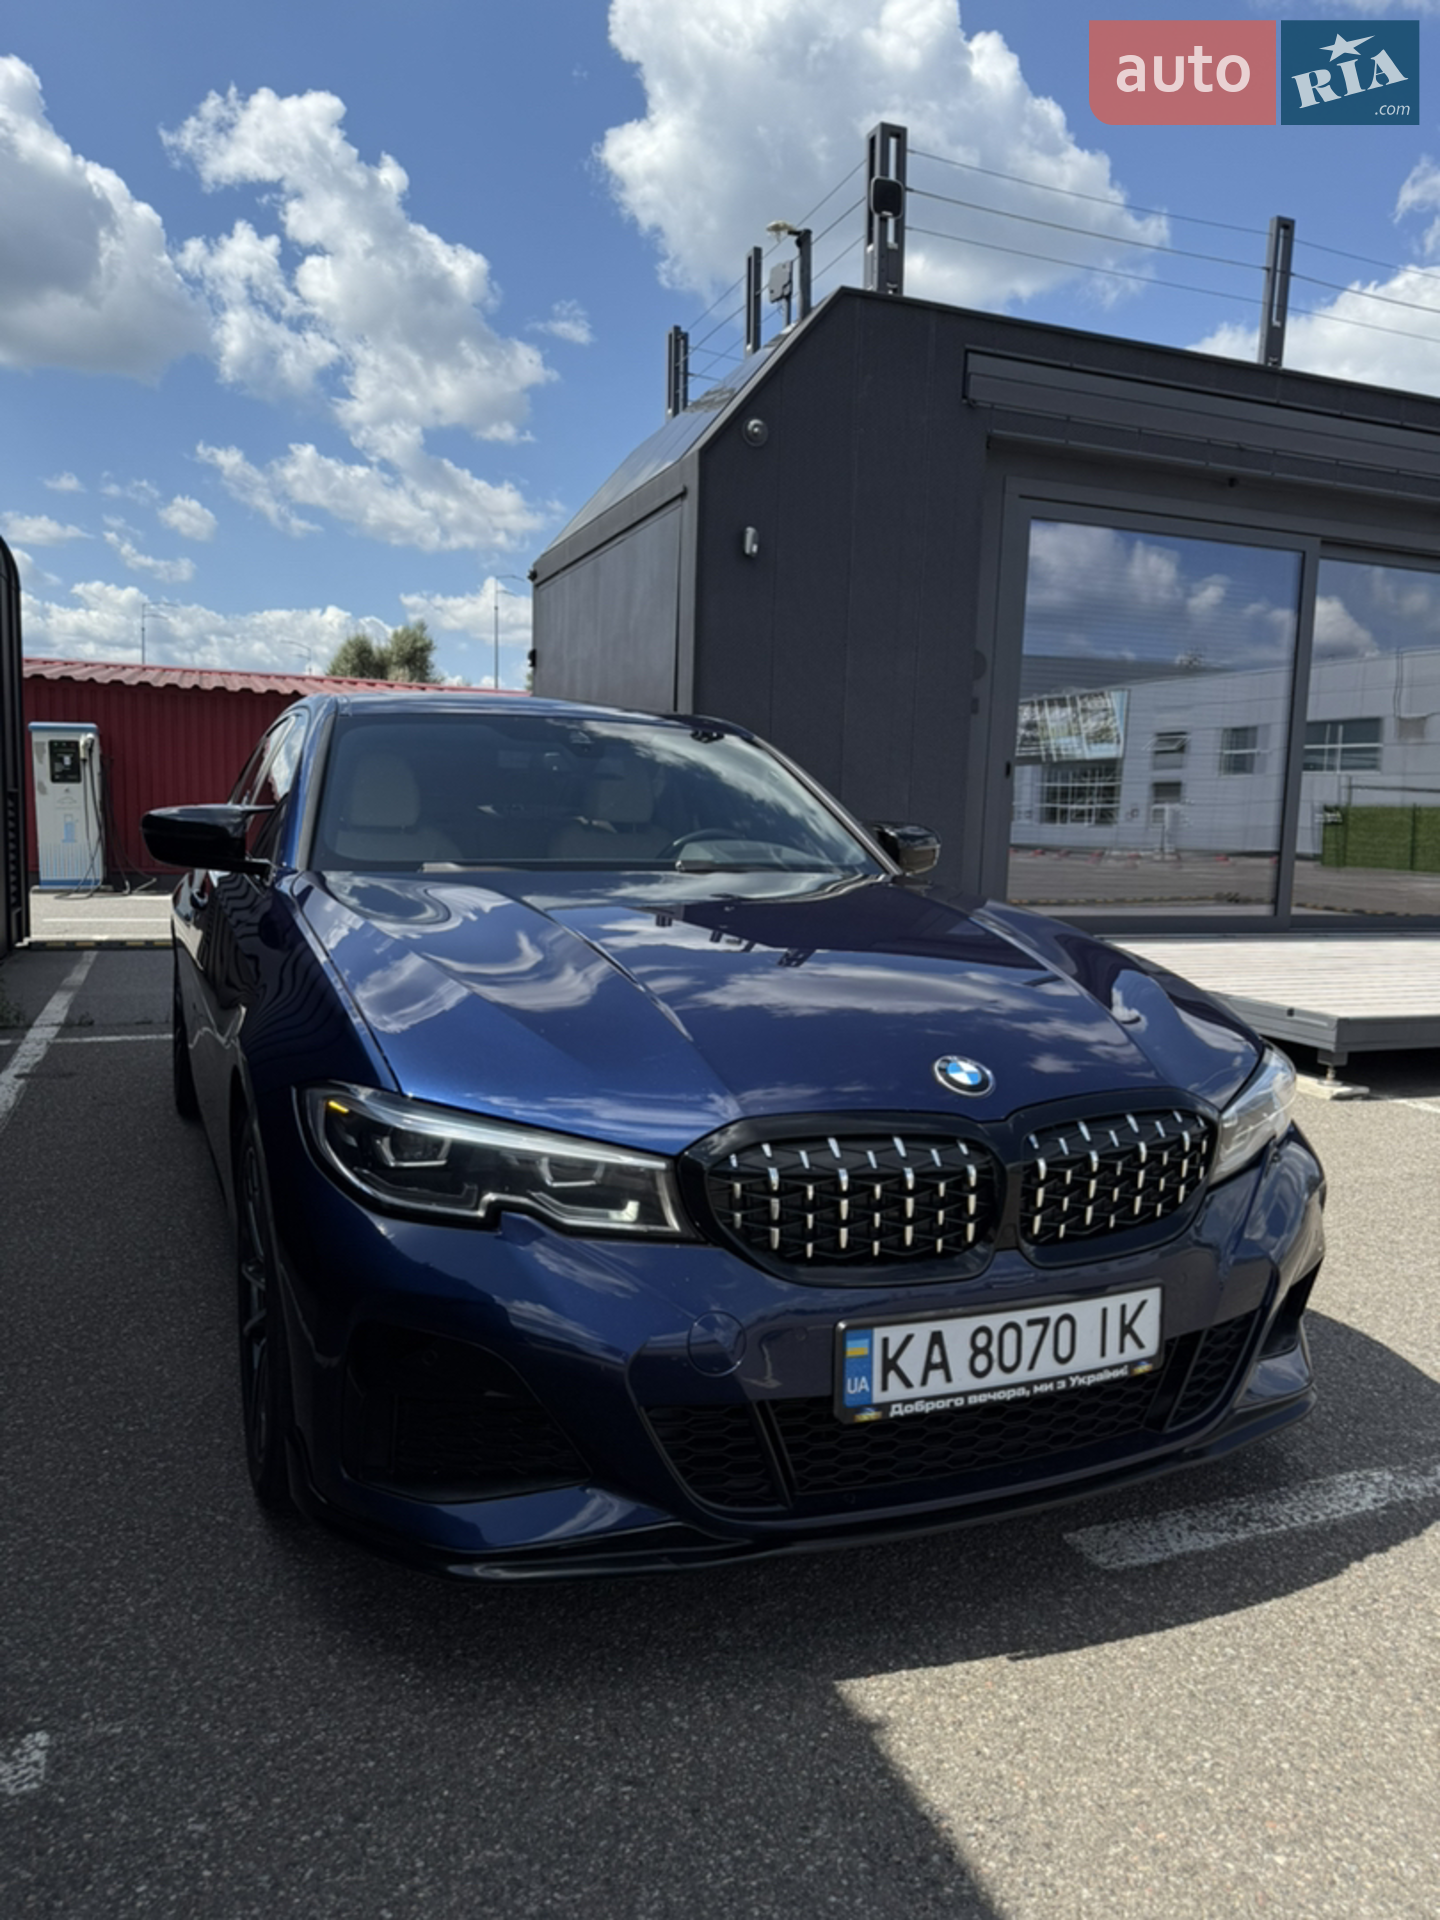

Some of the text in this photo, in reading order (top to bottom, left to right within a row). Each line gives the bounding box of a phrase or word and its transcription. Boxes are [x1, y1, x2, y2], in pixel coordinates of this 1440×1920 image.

[881, 1299, 1149, 1392] KA 8070 IK
[847, 1375, 870, 1395] UA
[889, 1397, 965, 1418] Доброго
[1033, 1382, 1054, 1394] ми
